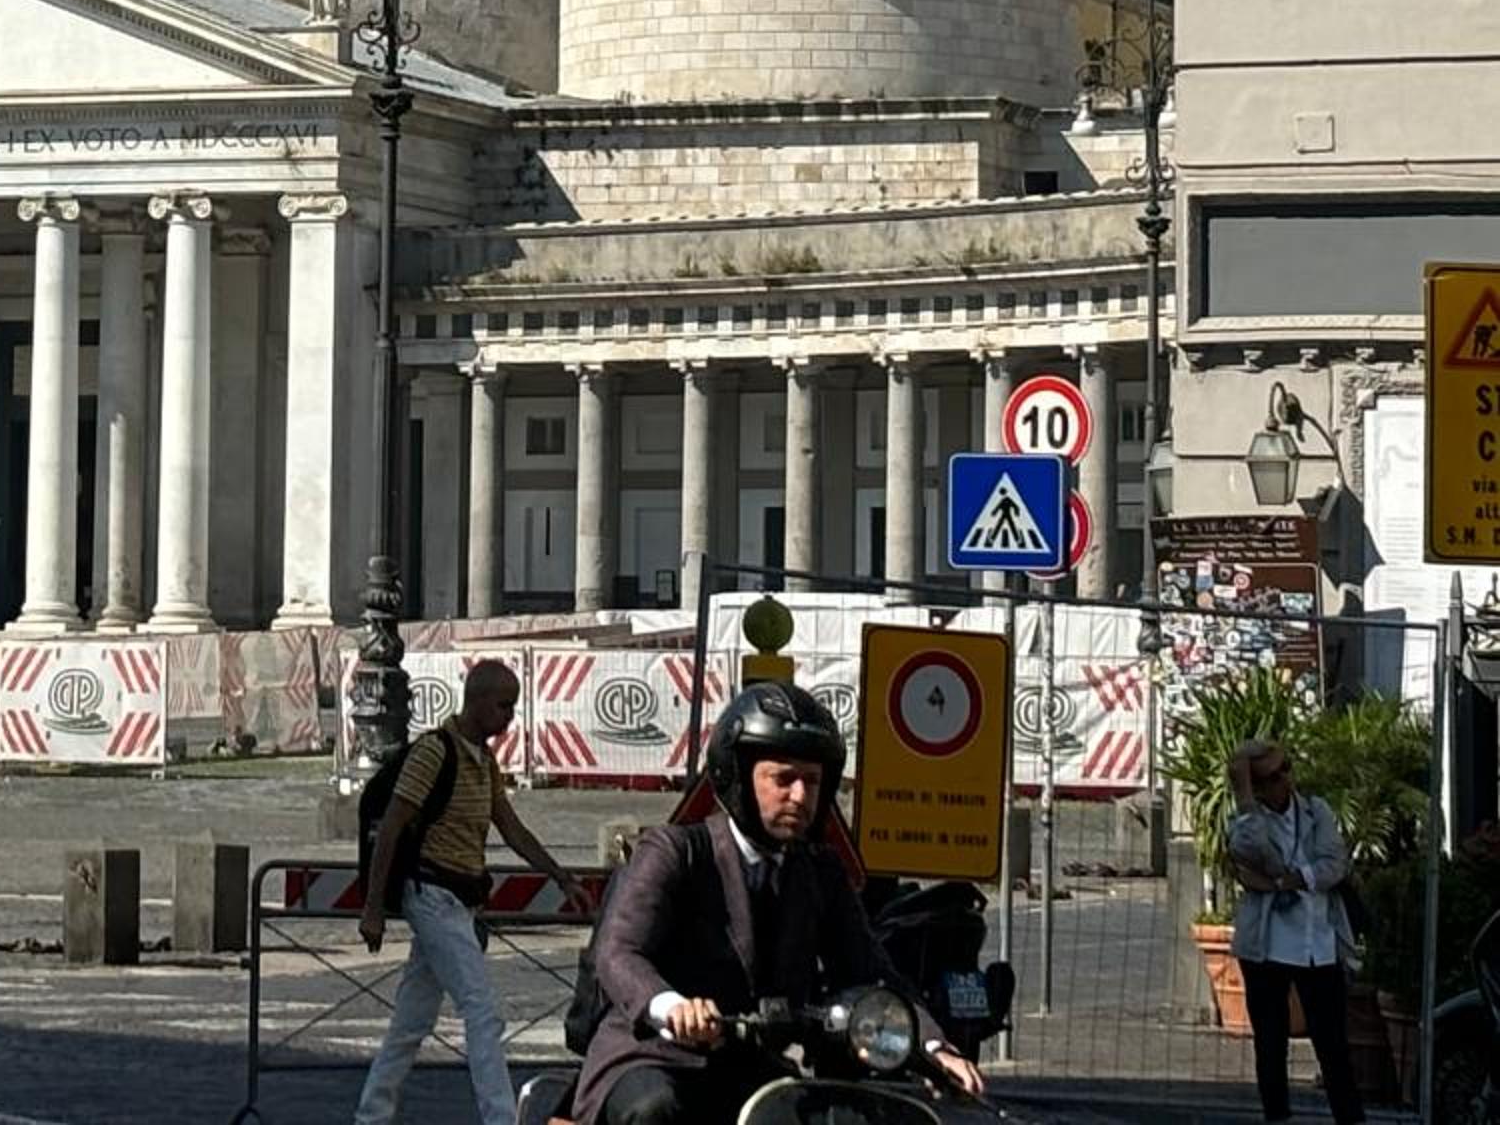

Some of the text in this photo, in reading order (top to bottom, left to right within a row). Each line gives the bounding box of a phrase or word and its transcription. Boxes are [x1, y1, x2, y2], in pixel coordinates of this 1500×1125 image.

[24, 129, 56, 154] EX
[67, 127, 142, 152] VOTO
[151, 127, 170, 150] A
[1022, 406, 1069, 449] 10
